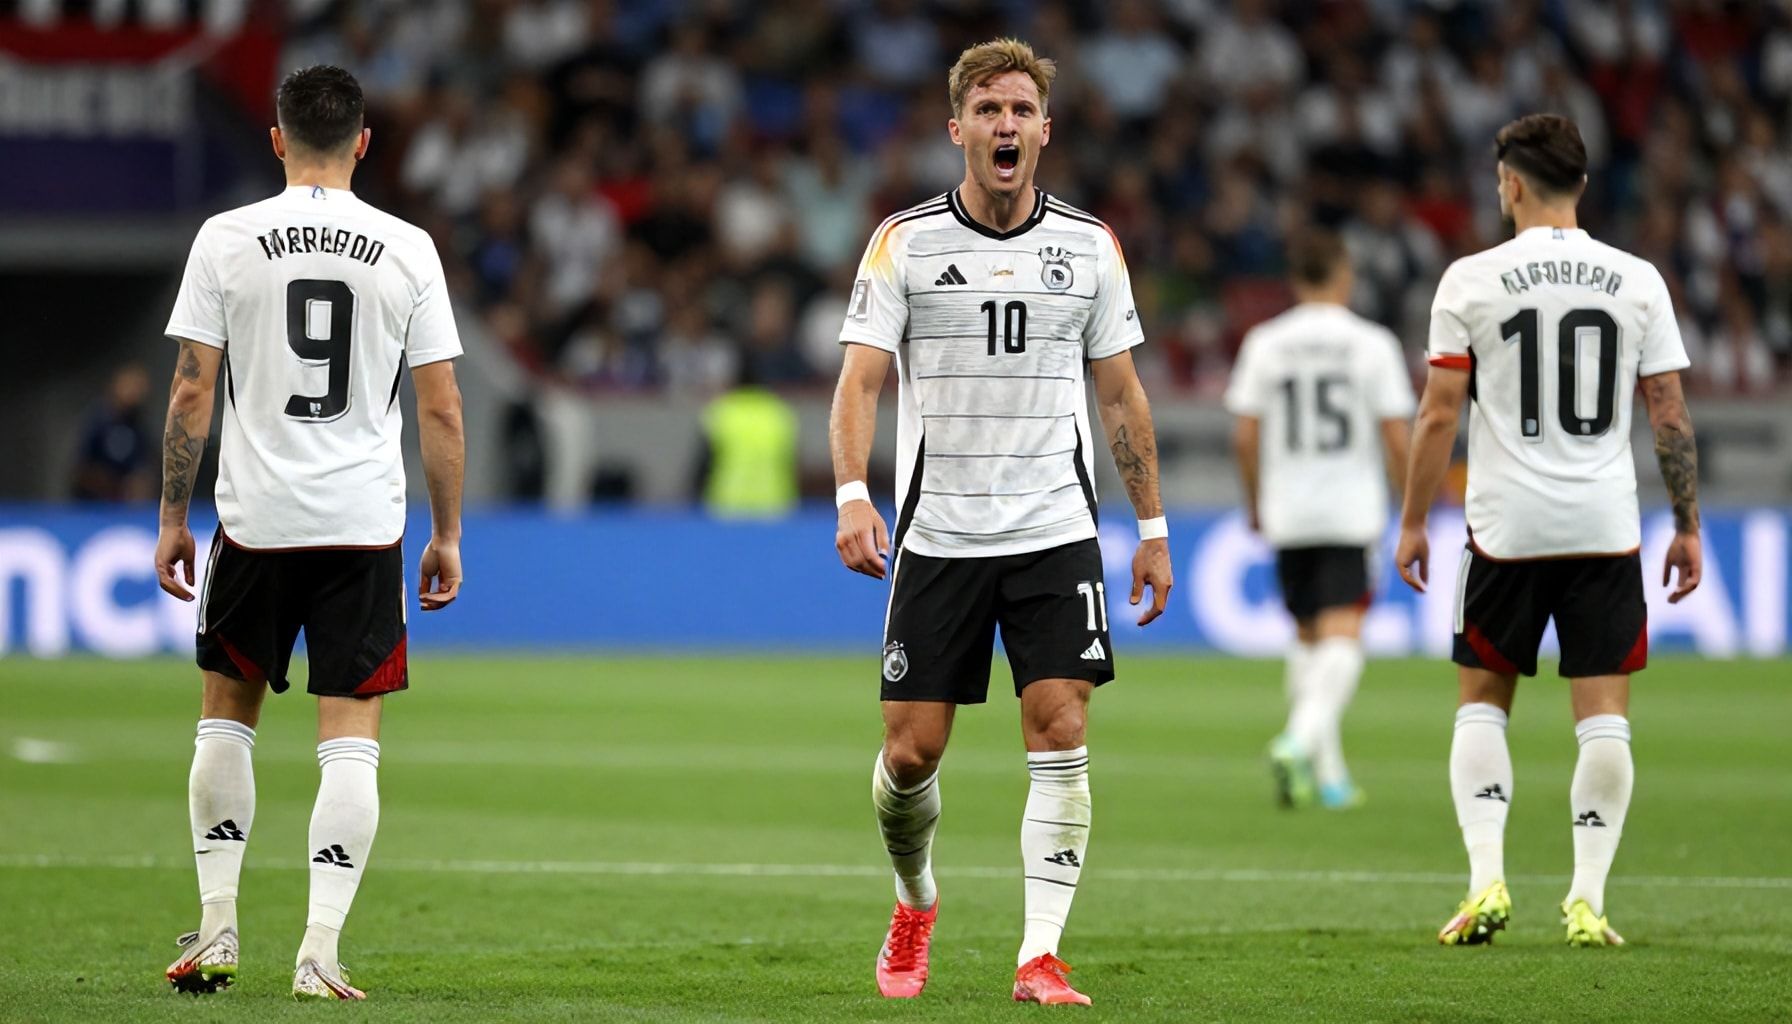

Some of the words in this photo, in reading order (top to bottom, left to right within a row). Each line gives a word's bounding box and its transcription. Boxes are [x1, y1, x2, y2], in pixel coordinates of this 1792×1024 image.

[284, 278, 357, 421] 9
[980, 300, 1026, 355] 10
[1501, 308, 1619, 437] 10
[1279, 371, 1353, 454] 15
